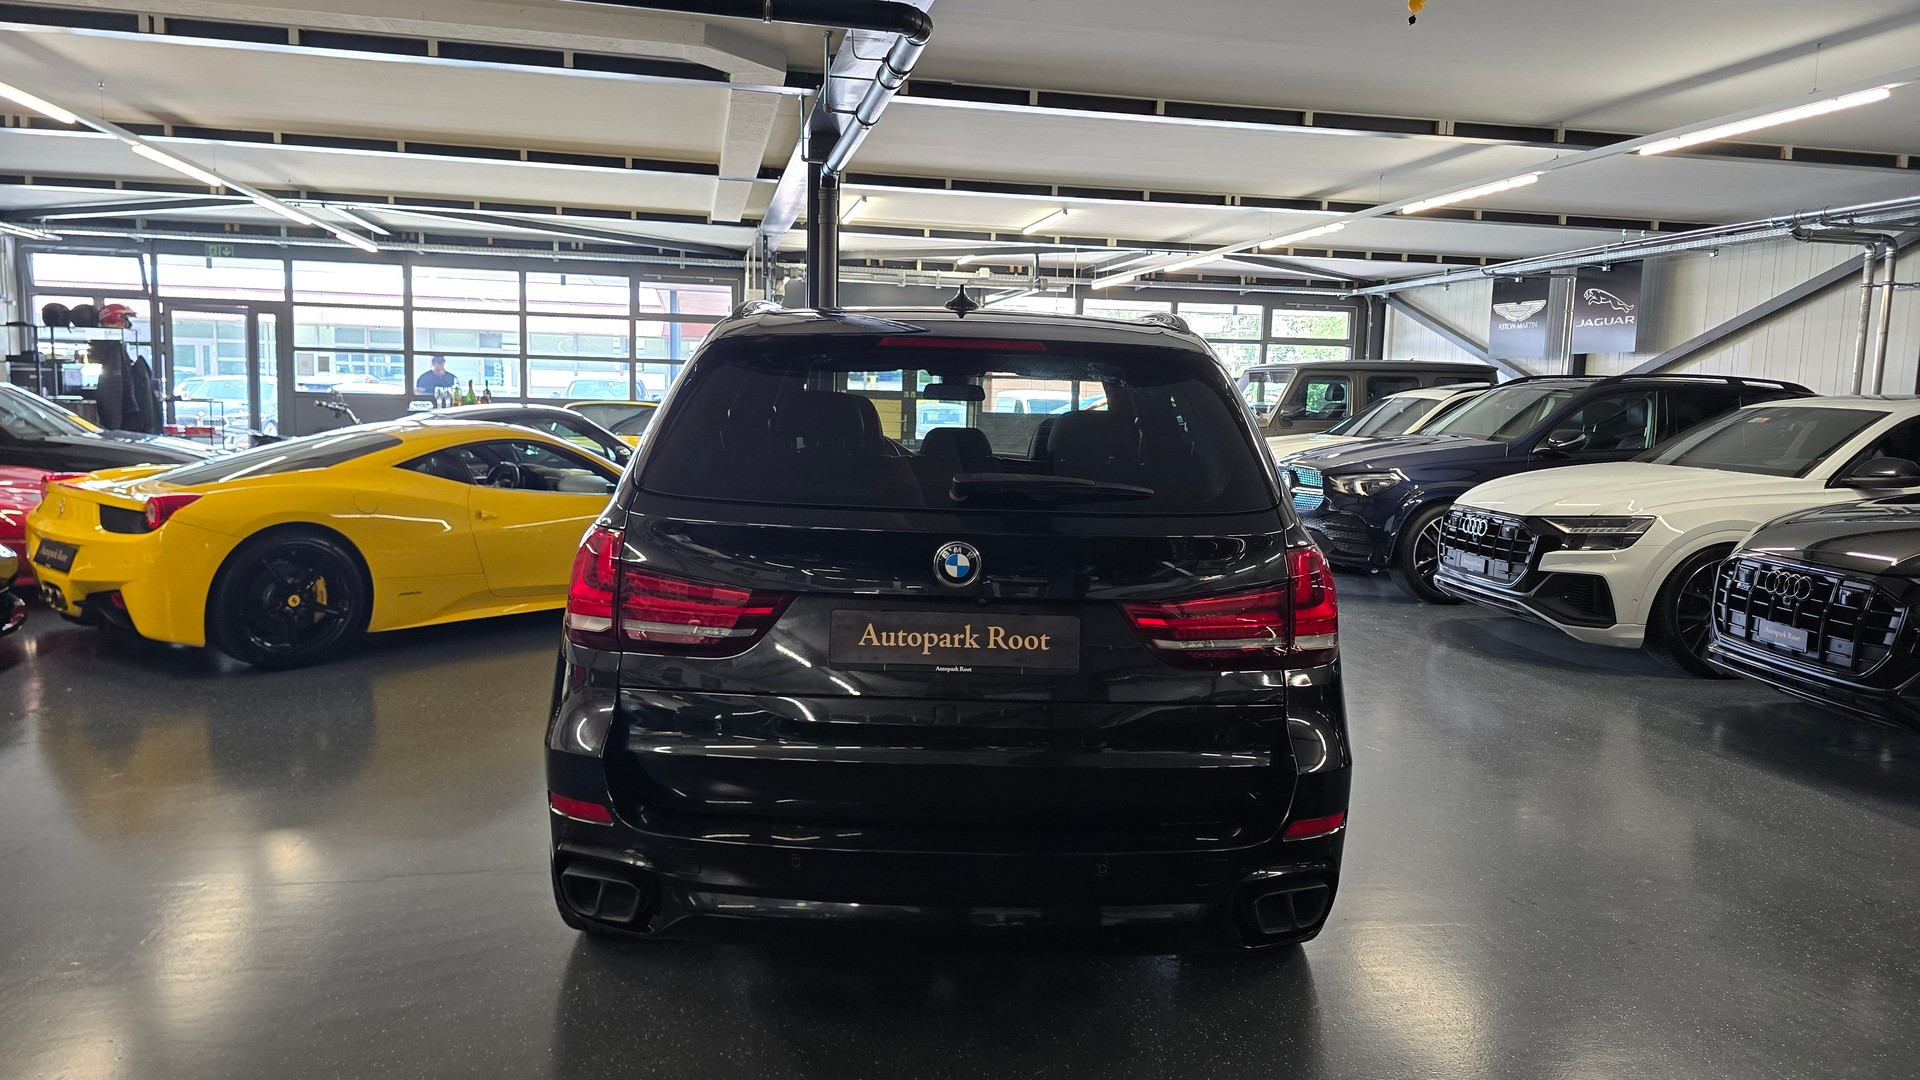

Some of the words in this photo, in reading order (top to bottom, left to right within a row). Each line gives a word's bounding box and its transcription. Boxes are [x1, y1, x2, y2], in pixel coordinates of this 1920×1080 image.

[1498, 322, 1516, 331] ASTON
[1516, 321, 1538, 330] MARTIN
[1576, 315, 1635, 328] JAGUAR
[941, 546, 975, 560] BMW
[858, 622, 980, 655] Autopark
[987, 626, 1051, 651] Root
[1764, 627, 1787, 638] Autopark
[1787, 632, 1800, 642] Root
[935, 665, 959, 673] Autopark
